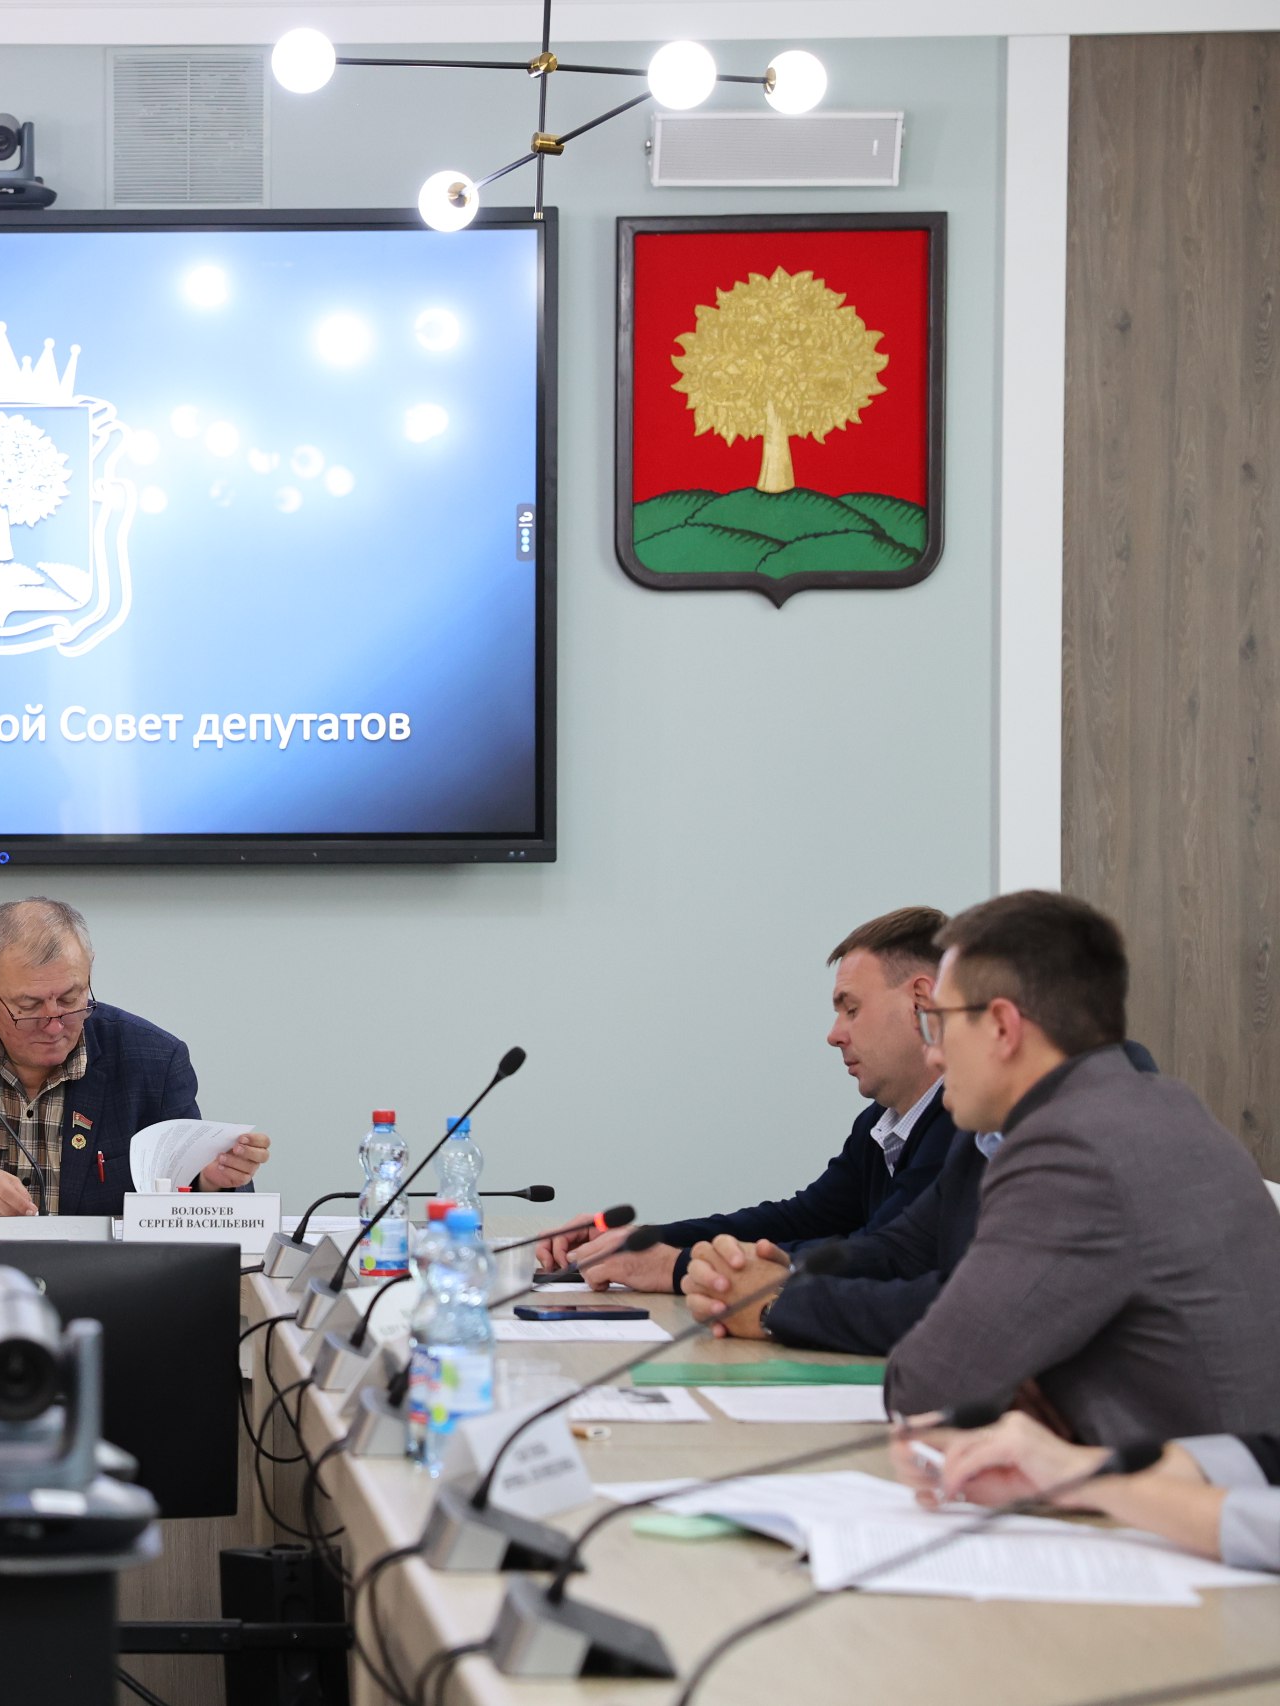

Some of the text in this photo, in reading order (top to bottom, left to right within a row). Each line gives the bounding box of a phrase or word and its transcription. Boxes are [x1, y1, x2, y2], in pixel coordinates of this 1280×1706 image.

[59, 705, 183, 743] Совет
[193, 712, 411, 750] депутатов
[171, 1206, 234, 1216] ВОЛОБУЕВ
[138, 1217, 265, 1229] СЕРГЕЙ ВАСИЛЬЕВИЧ
